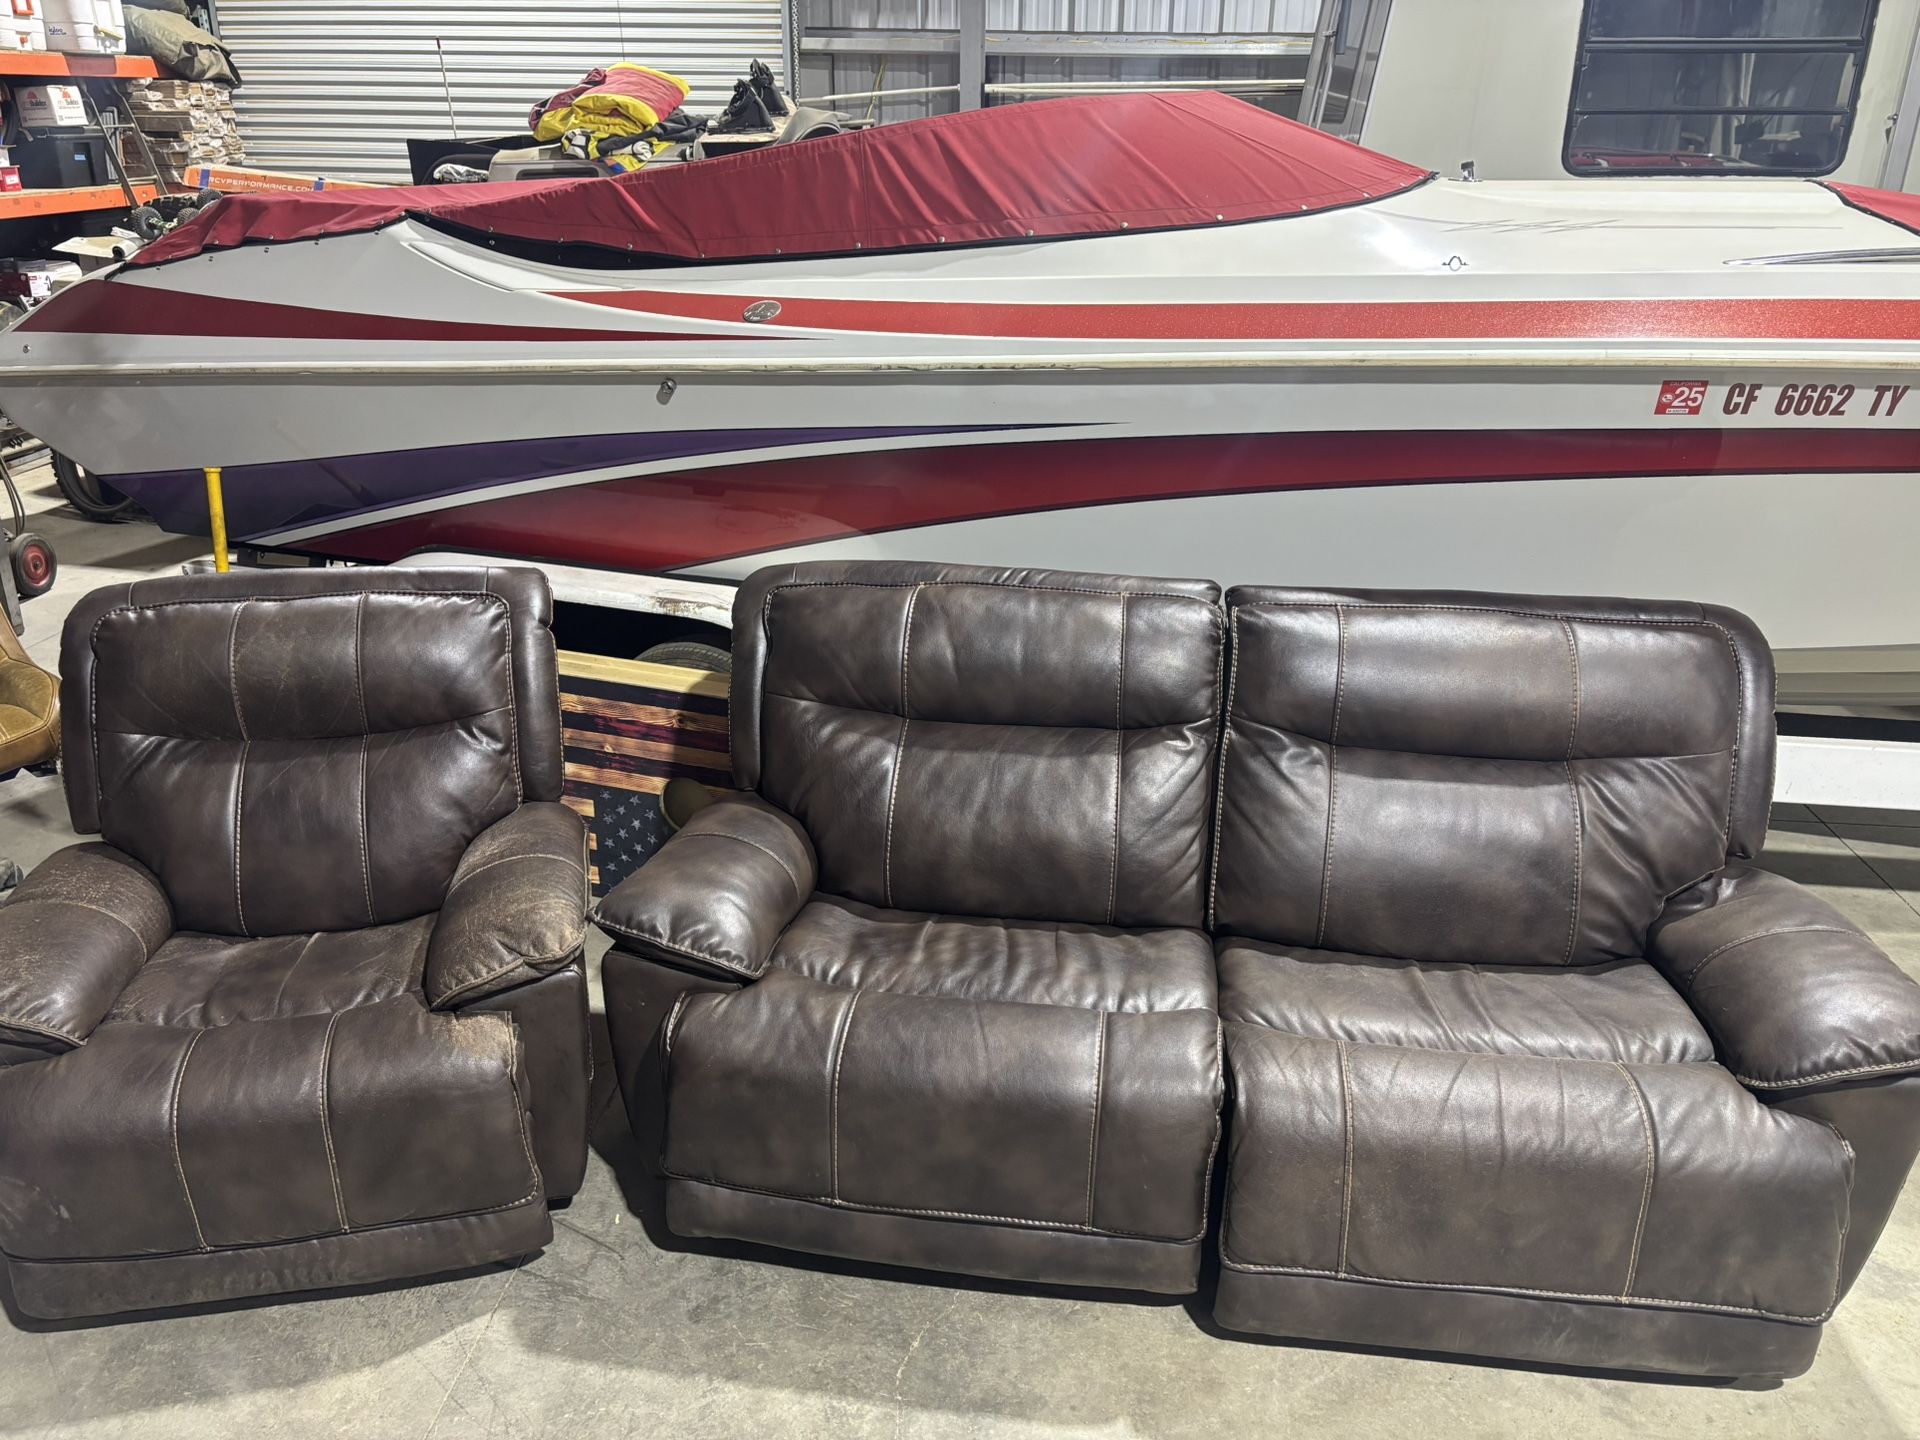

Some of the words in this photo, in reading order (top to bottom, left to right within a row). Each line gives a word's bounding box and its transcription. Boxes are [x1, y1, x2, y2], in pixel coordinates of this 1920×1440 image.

[1671, 386, 1705, 407] 25
[1722, 382, 1763, 415] CF
[1774, 383, 1855, 416] 6662
[1867, 385, 1910, 416] TY
